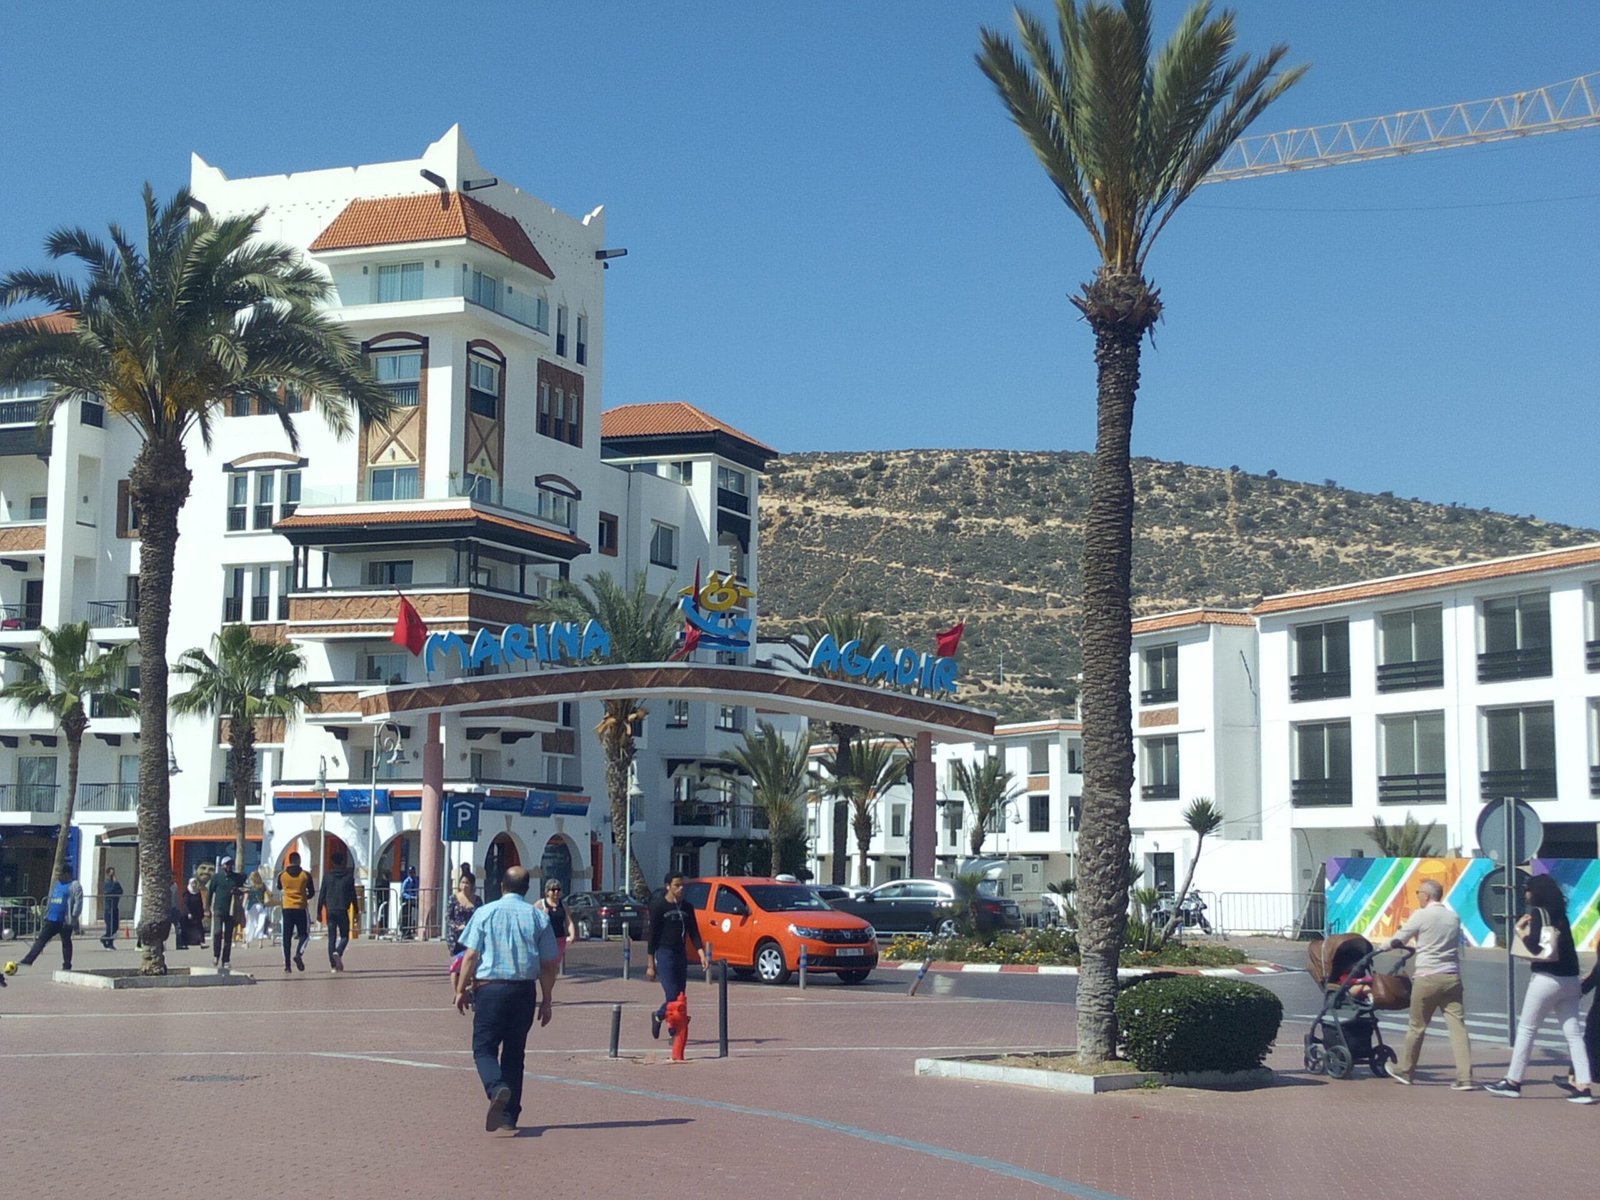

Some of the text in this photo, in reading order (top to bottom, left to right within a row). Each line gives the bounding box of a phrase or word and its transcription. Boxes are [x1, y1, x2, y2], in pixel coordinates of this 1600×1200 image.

[424, 618, 958, 693] MARINA AGADIR
[457, 808, 472, 828] P
